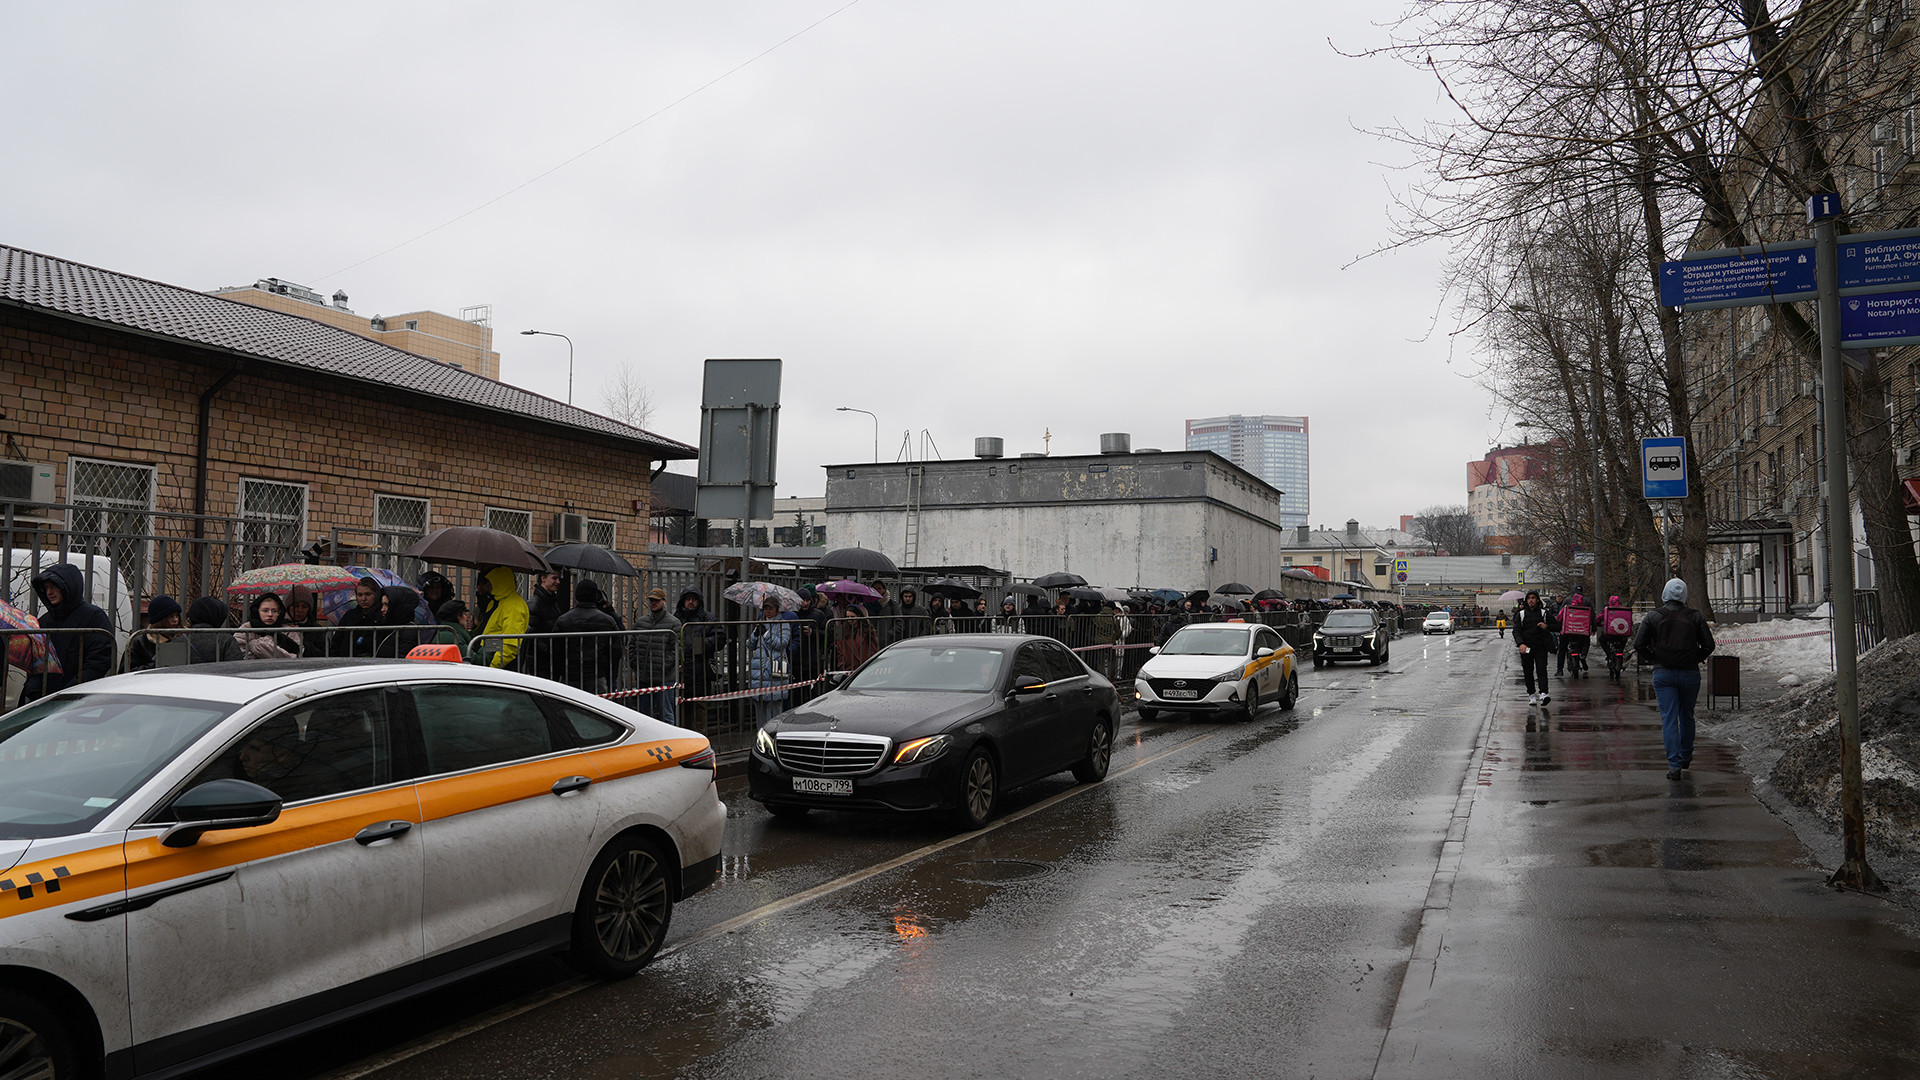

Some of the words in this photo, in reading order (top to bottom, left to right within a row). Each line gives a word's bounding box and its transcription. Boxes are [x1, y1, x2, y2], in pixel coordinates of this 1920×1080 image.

[1730, 259, 1759, 268] Божией
[1761, 256, 1789, 264] матери
[1883, 253, 1902, 263] Д.А.
[1864, 263, 1898, 271] Furmanov
[1683, 271, 1714, 280] «Отрада
[1721, 266, 1765, 277] утешение»
[1682, 279, 1704, 287] Church
[1737, 280, 1779, 289] Consolatin»
[1866, 298, 1913, 308] Нотариус
[1867, 310, 1896, 318] Notary
[1896, 307, 1906, 315] in
[1906, 307, 1920, 315] Mo
[834, 780, 850, 789] 799
